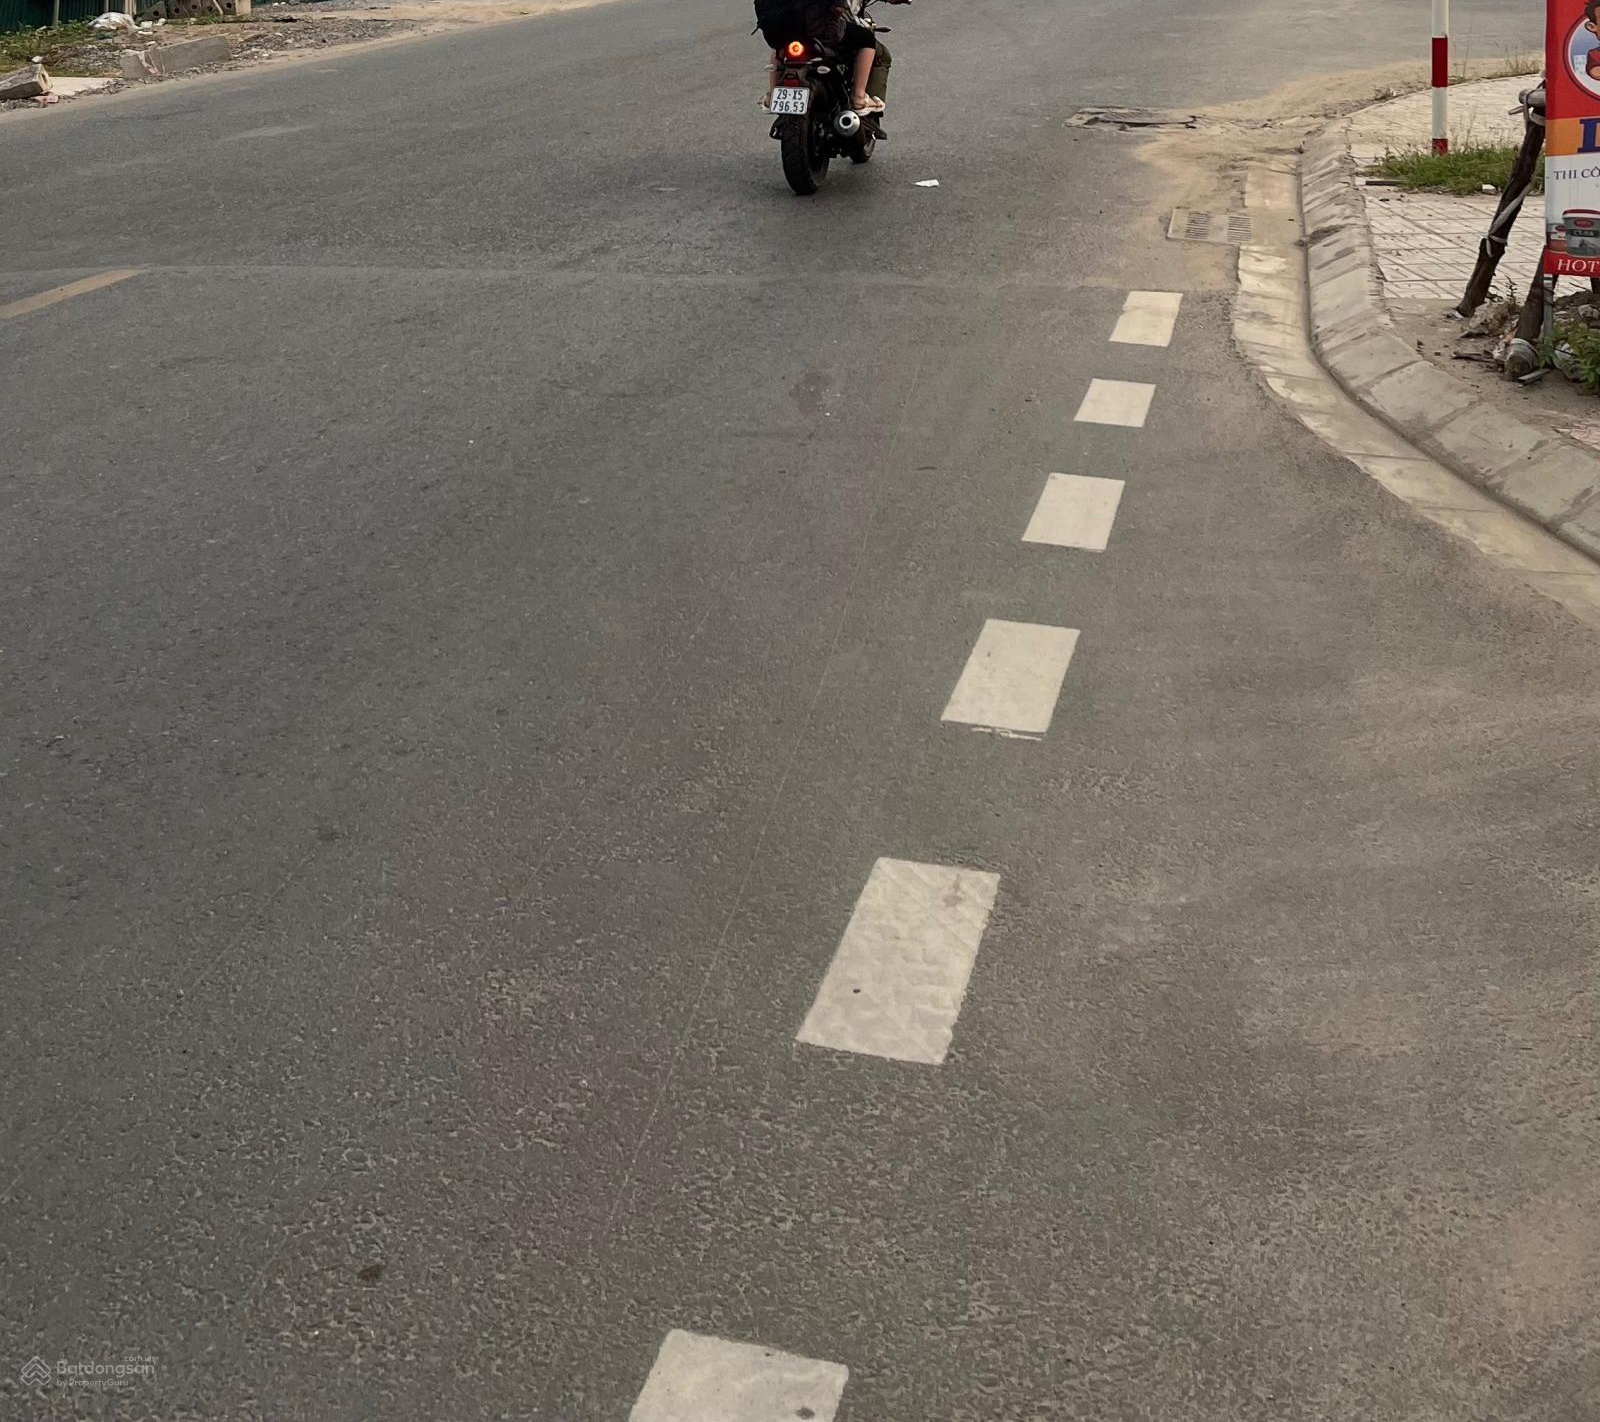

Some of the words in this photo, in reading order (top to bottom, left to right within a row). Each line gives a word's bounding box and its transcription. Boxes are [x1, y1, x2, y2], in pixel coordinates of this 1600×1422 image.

[776, 89, 804, 100] 29-X5
[772, 100, 805, 113] 796.53
[1553, 169, 1577, 180] THI
[1558, 259, 1600, 273] HOT
